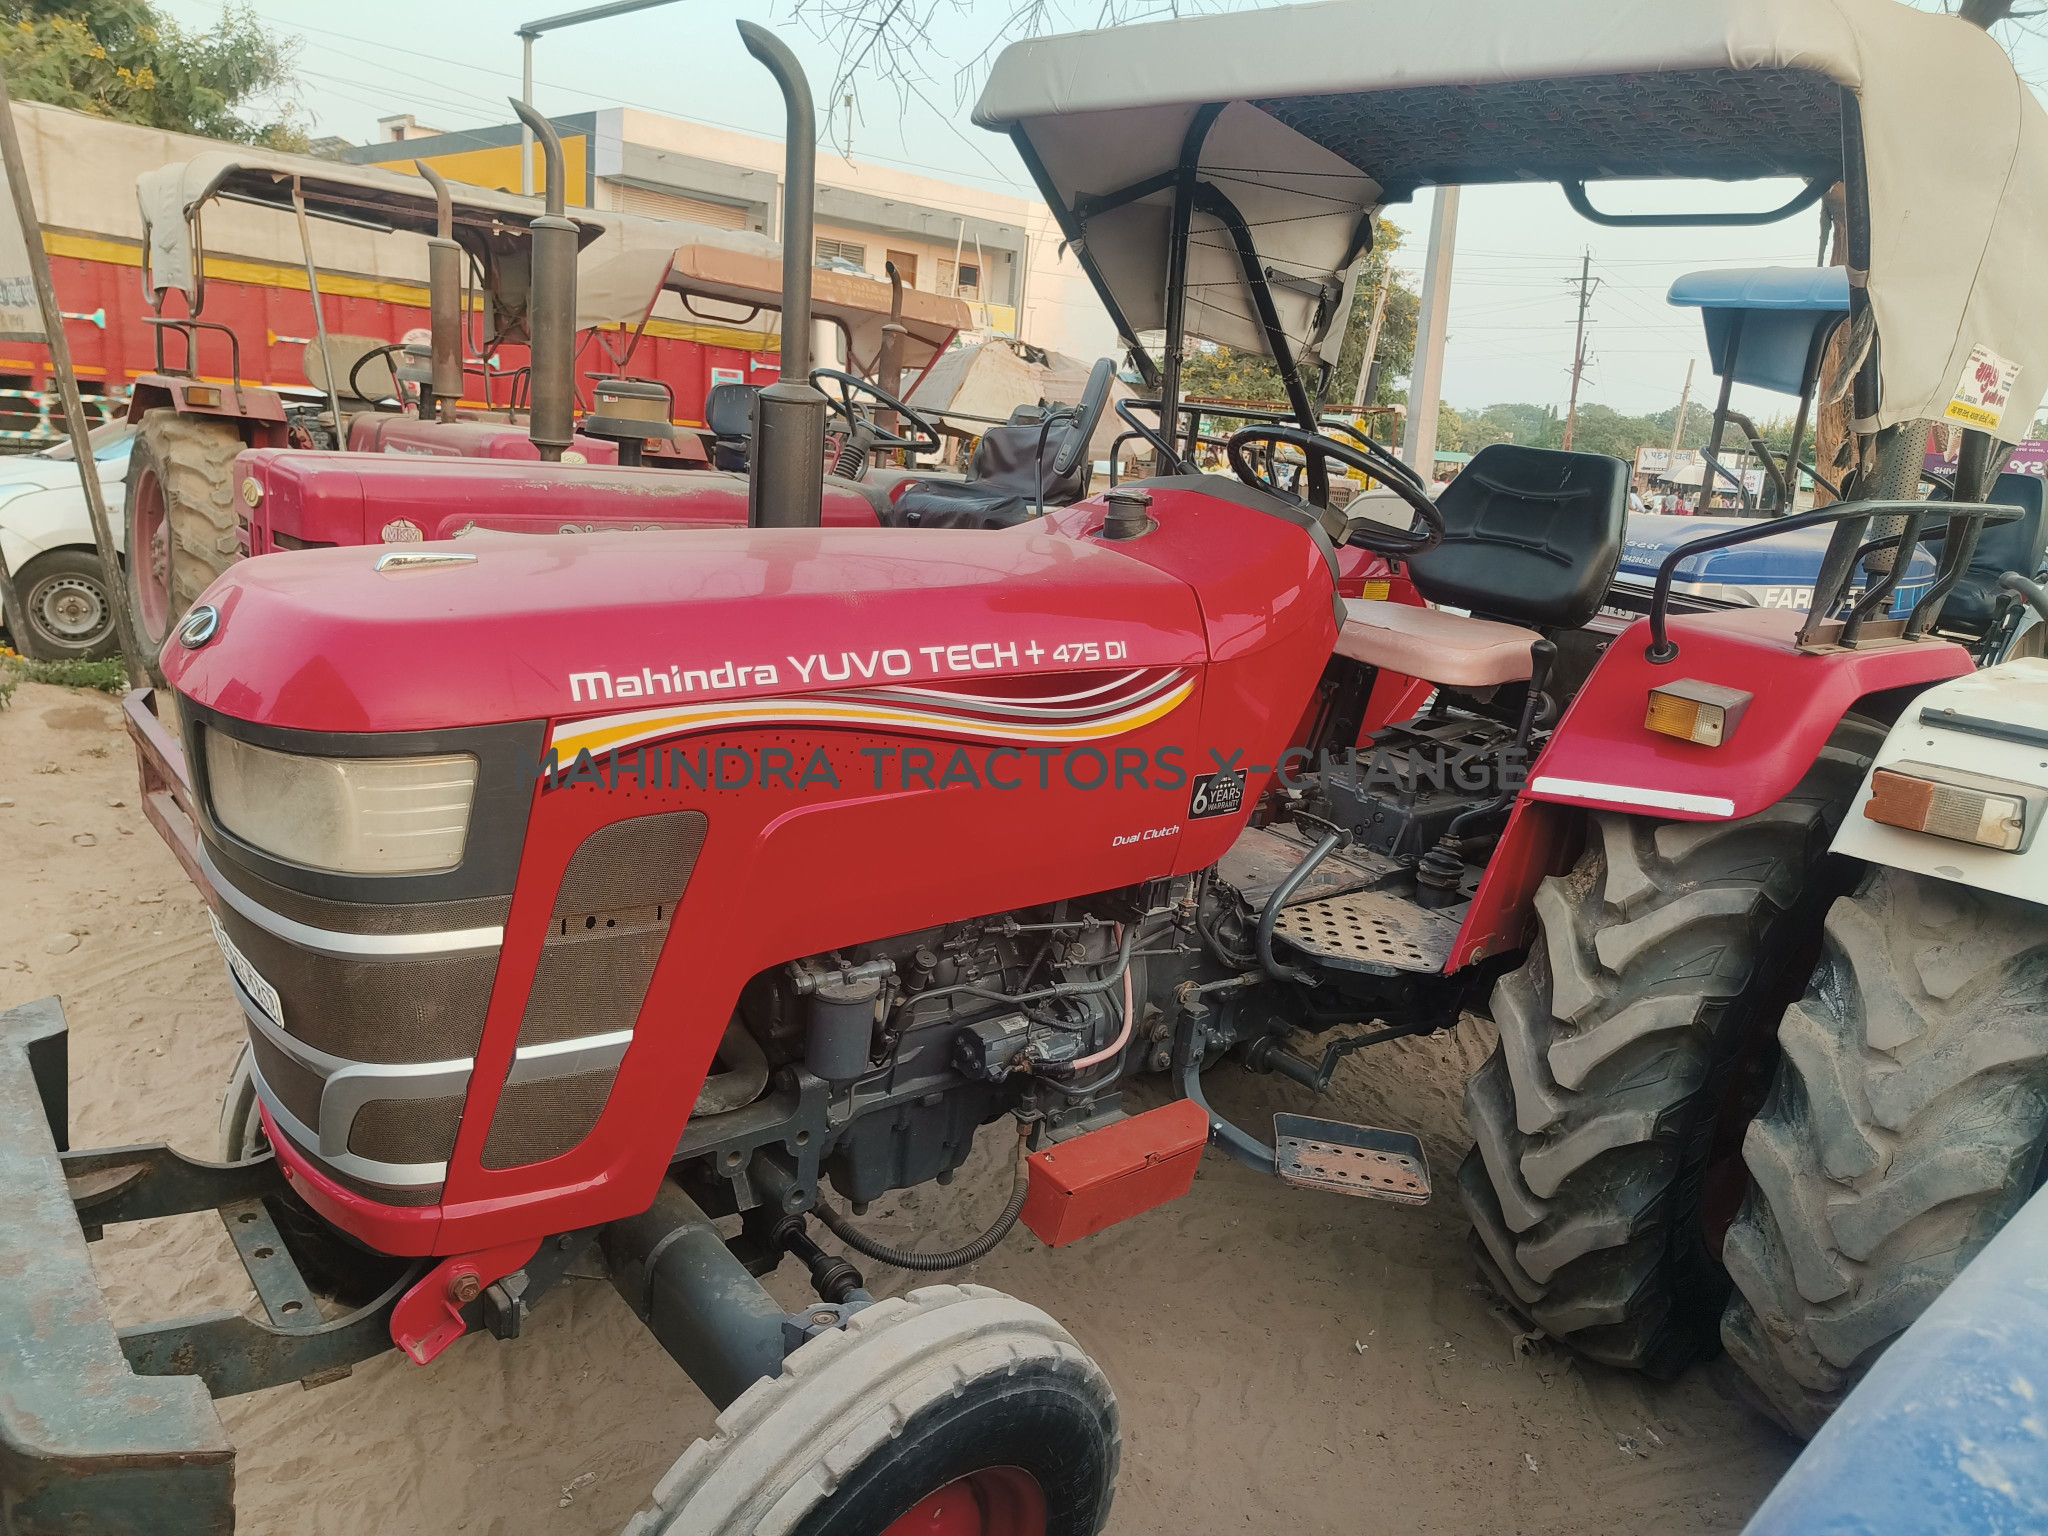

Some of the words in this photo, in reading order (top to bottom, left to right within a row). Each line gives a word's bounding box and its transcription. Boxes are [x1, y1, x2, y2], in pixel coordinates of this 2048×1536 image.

[569, 661, 778, 702] Mahindra
[786, 649, 911, 684] YUVO
[919, 641, 1018, 673] TECH
[1053, 642, 1090, 663] 475
[1105, 640, 1127, 660] DI
[1192, 782, 1208, 814] 6
[1207, 799, 1240, 811] WARRANTY
[1210, 787, 1241, 803] YEARS
[1112, 832, 1141, 847] Dual
[1143, 824, 1180, 841] Clutch
